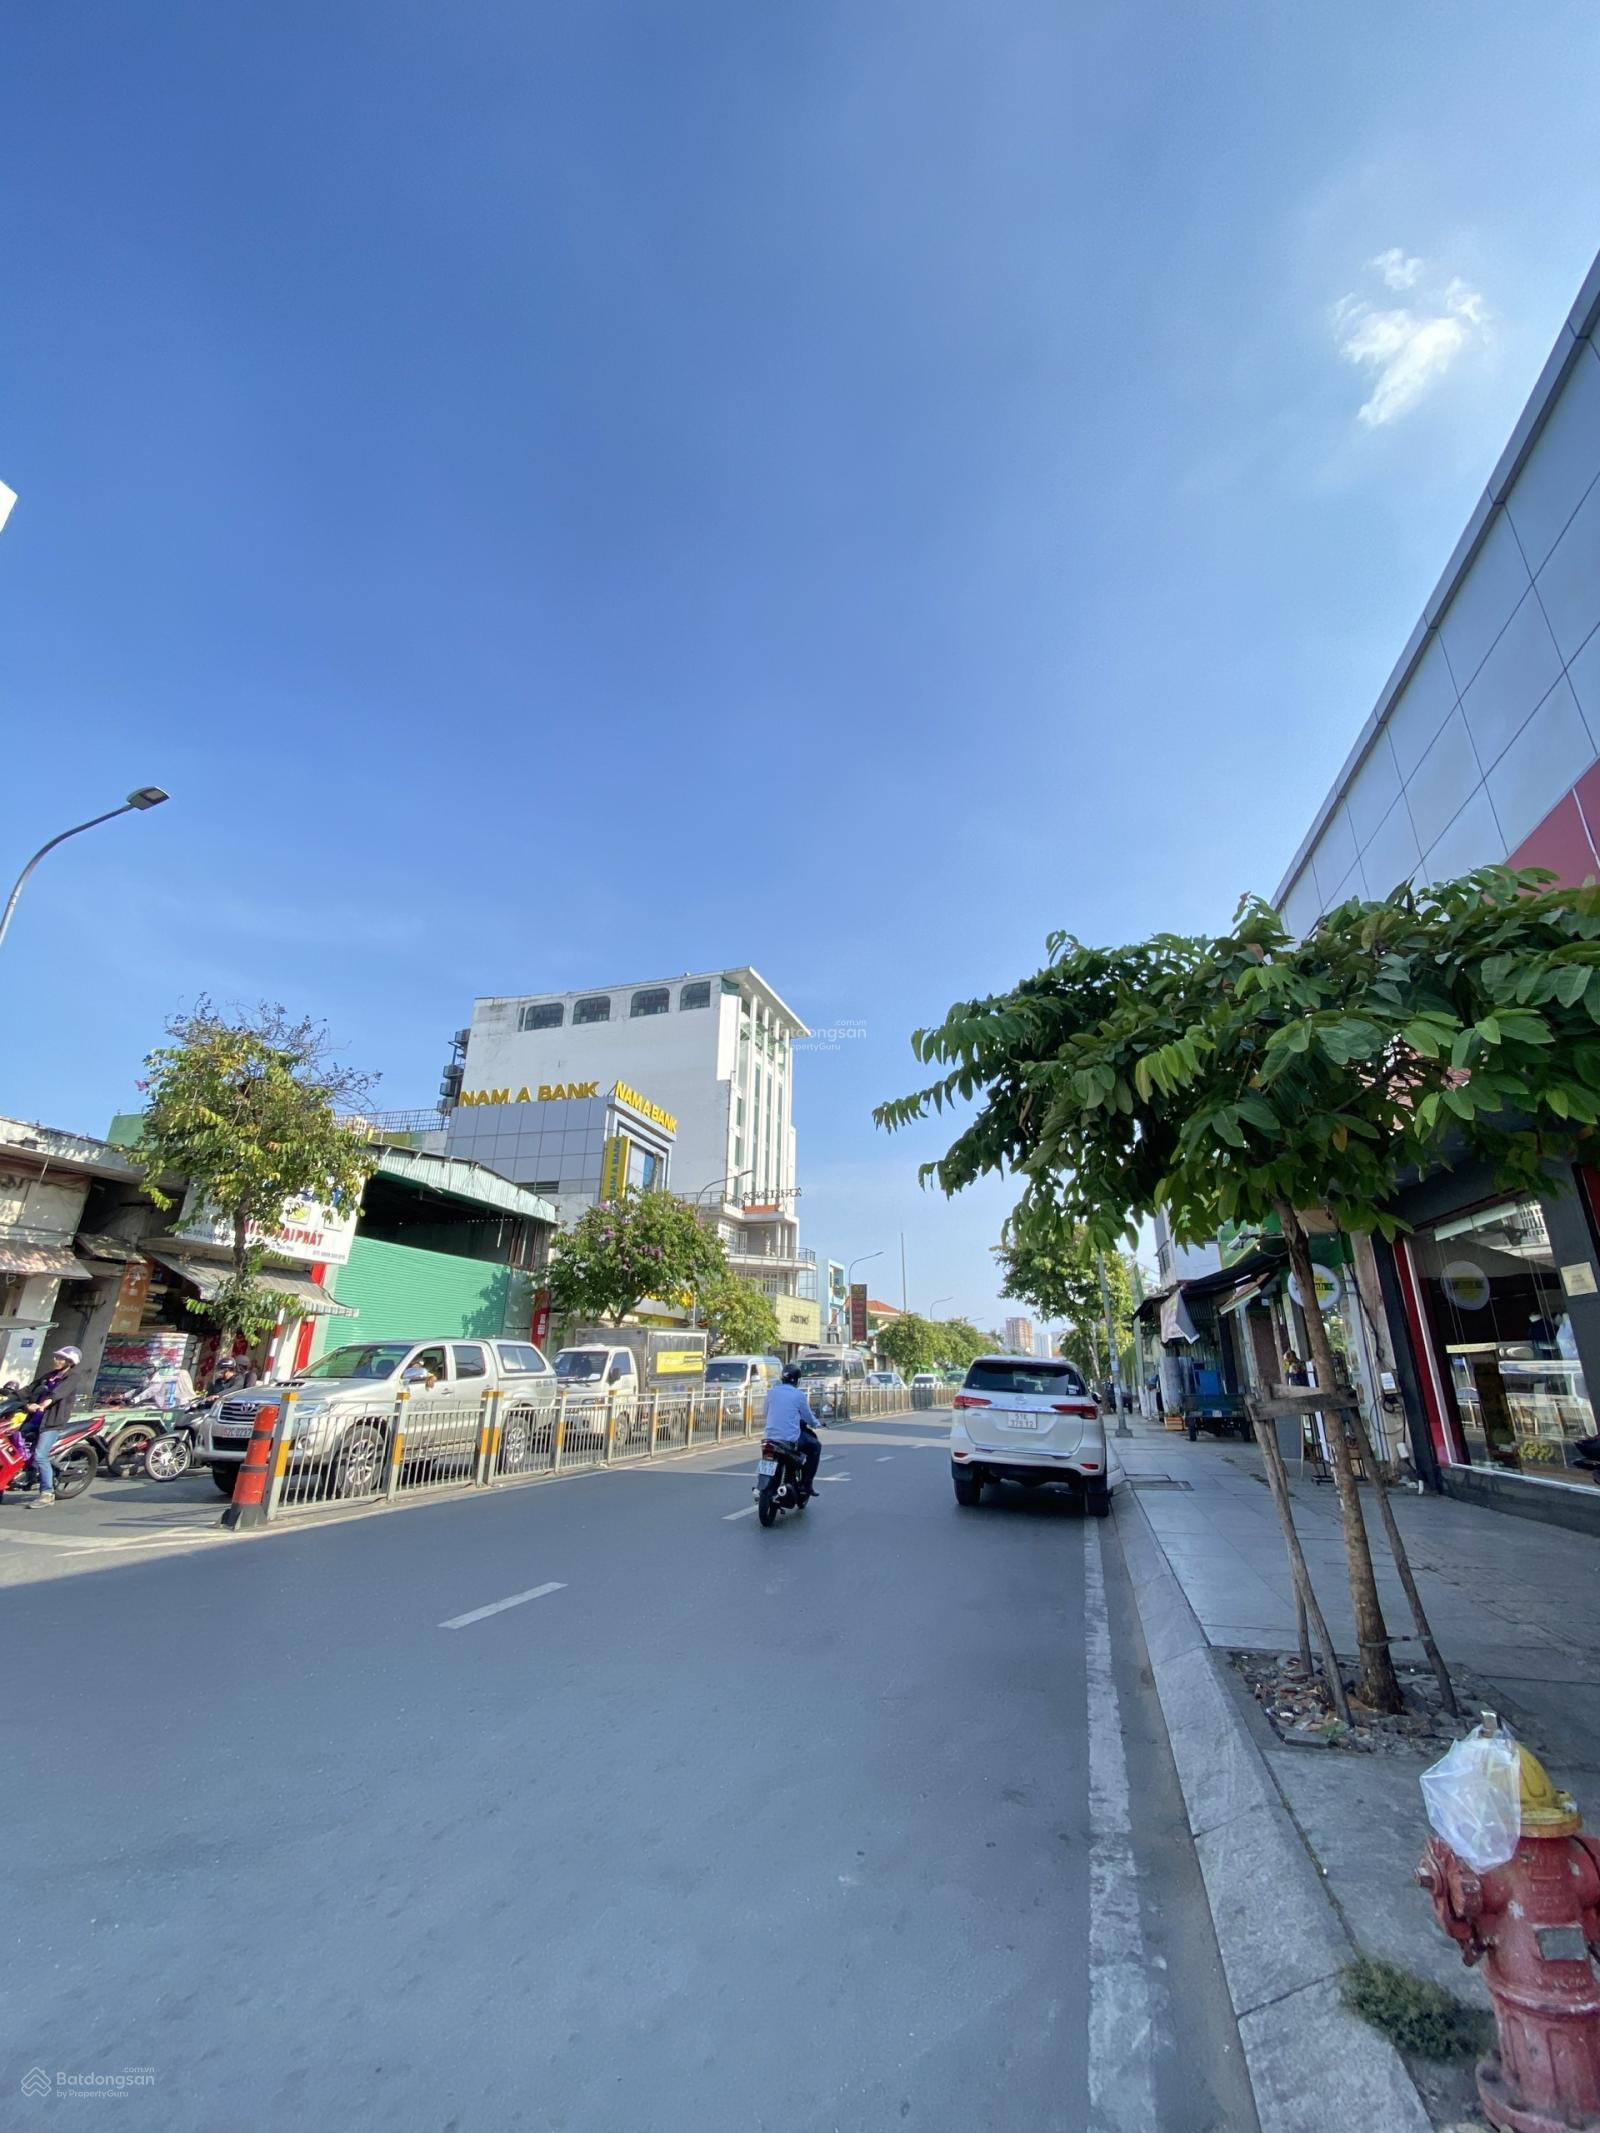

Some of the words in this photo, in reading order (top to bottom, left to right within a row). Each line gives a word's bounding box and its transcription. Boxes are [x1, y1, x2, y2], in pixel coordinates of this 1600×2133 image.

[459, 1087, 512, 1107] NAM
[515, 1086, 532, 1104] A
[537, 1081, 600, 1101] BANK
[615, 1080, 643, 1111] NAM
[642, 1099, 653, 1117] A
[650, 1103, 678, 1134] BANK
